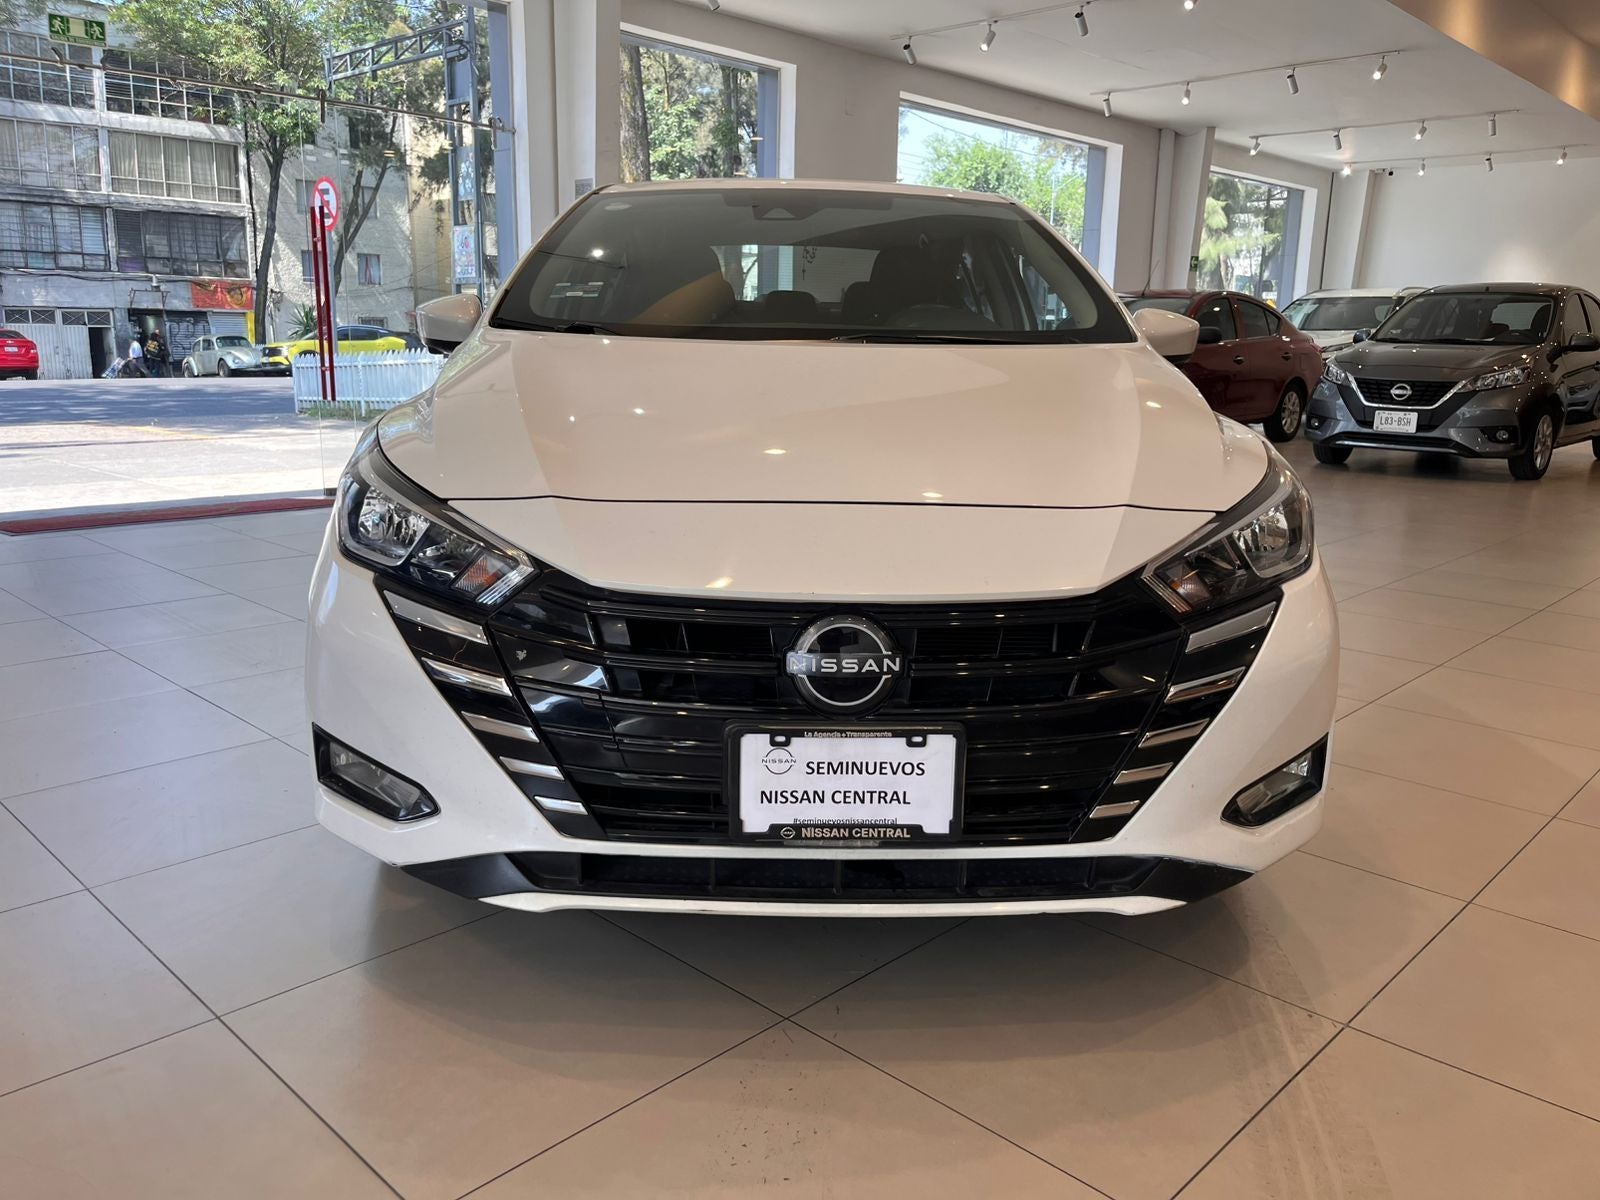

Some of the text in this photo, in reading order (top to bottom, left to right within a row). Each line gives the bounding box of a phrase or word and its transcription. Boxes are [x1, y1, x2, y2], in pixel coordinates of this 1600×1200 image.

[1379, 415, 1412, 427] L83-BSH
[789, 657, 900, 673] NISSAN
[805, 760, 926, 776] SEMINUEVOS
[760, 789, 911, 805] NISSAN CENTRAL
[793, 817, 898, 825] #seminuevosnissancentral
[801, 827, 849, 838] NISSAN
[852, 827, 911, 838] CENTRAL
